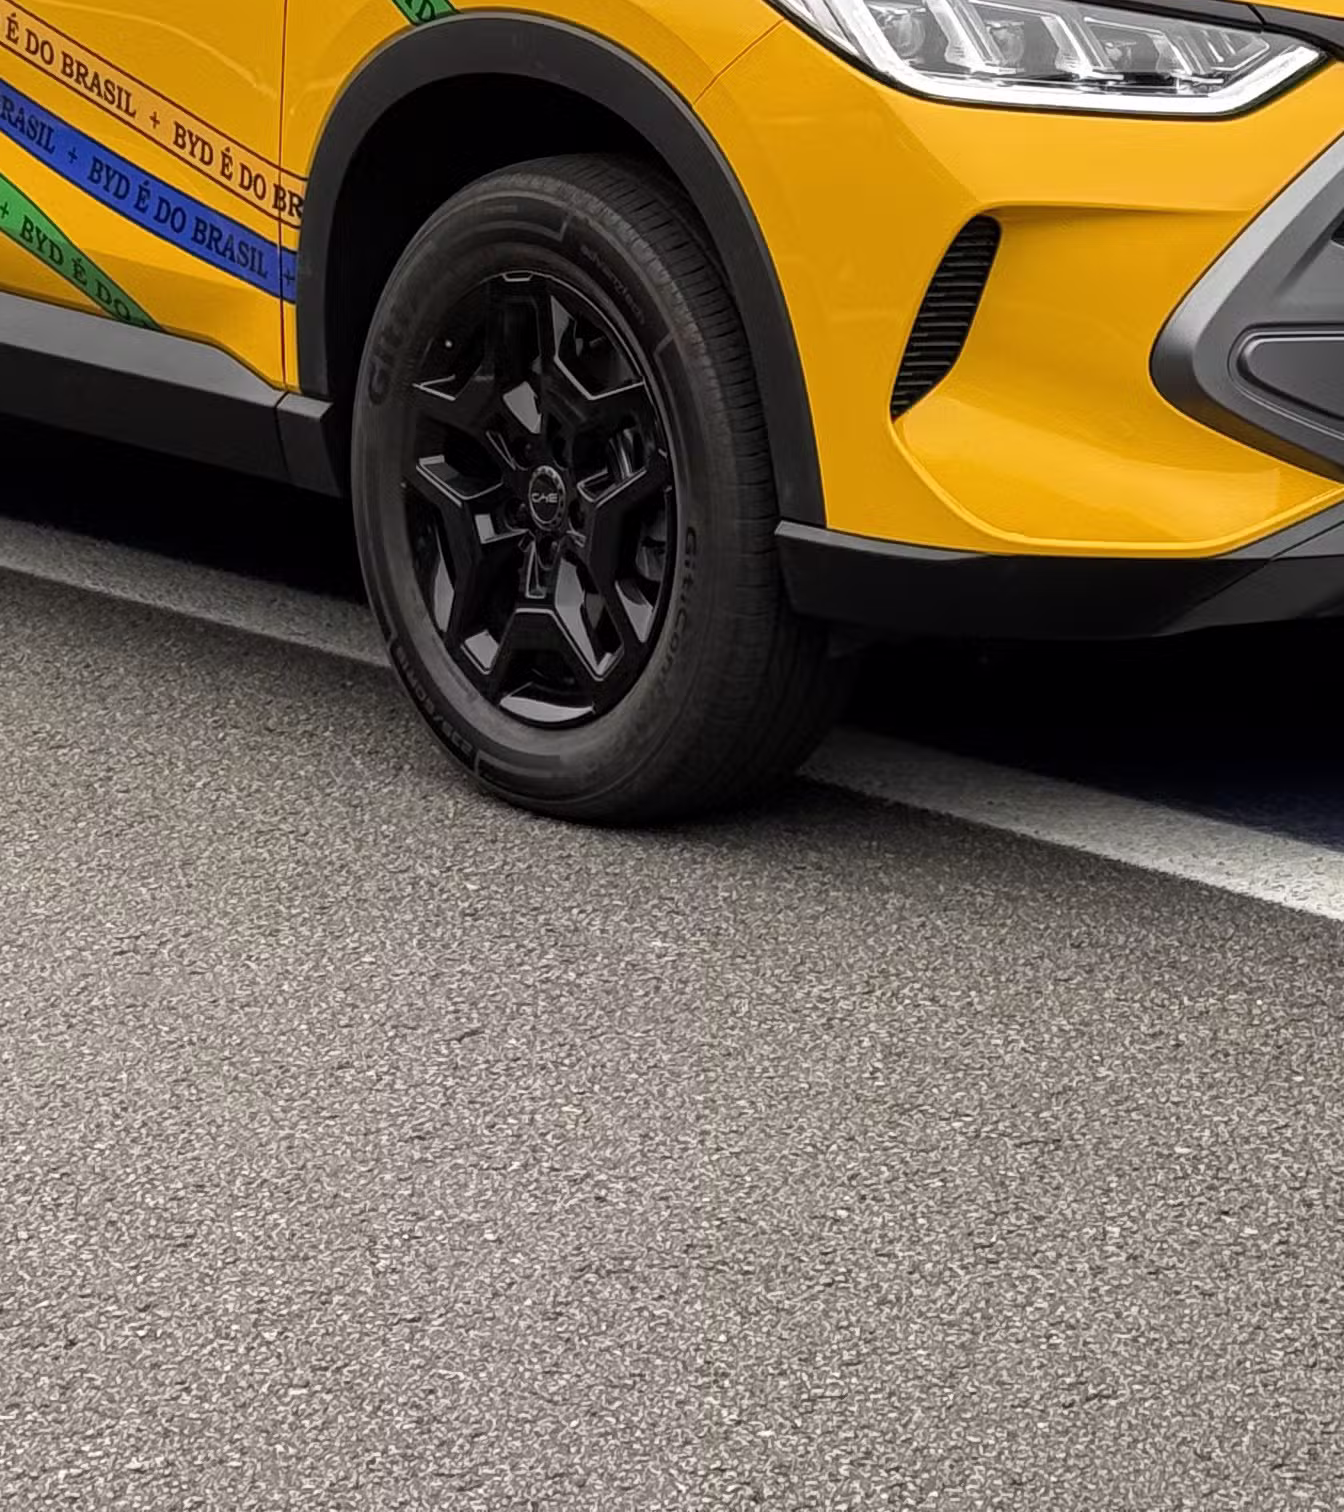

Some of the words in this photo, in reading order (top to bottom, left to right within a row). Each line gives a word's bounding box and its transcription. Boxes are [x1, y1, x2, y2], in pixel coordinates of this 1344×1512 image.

[5, 11, 19, 45] É
[24, 28, 54, 65] DO
[61, 52, 136, 117] BRASIL
[172, 121, 214, 166] BYD
[219, 145, 233, 181] É
[238, 163, 267, 200] DO
[19, 215, 64, 265] BYD
[70, 256, 88, 286] É
[86, 156, 130, 200] BYD
[132, 179, 151, 214] É
[152, 197, 186, 234] DO
[191, 217, 268, 278] BRASIL
